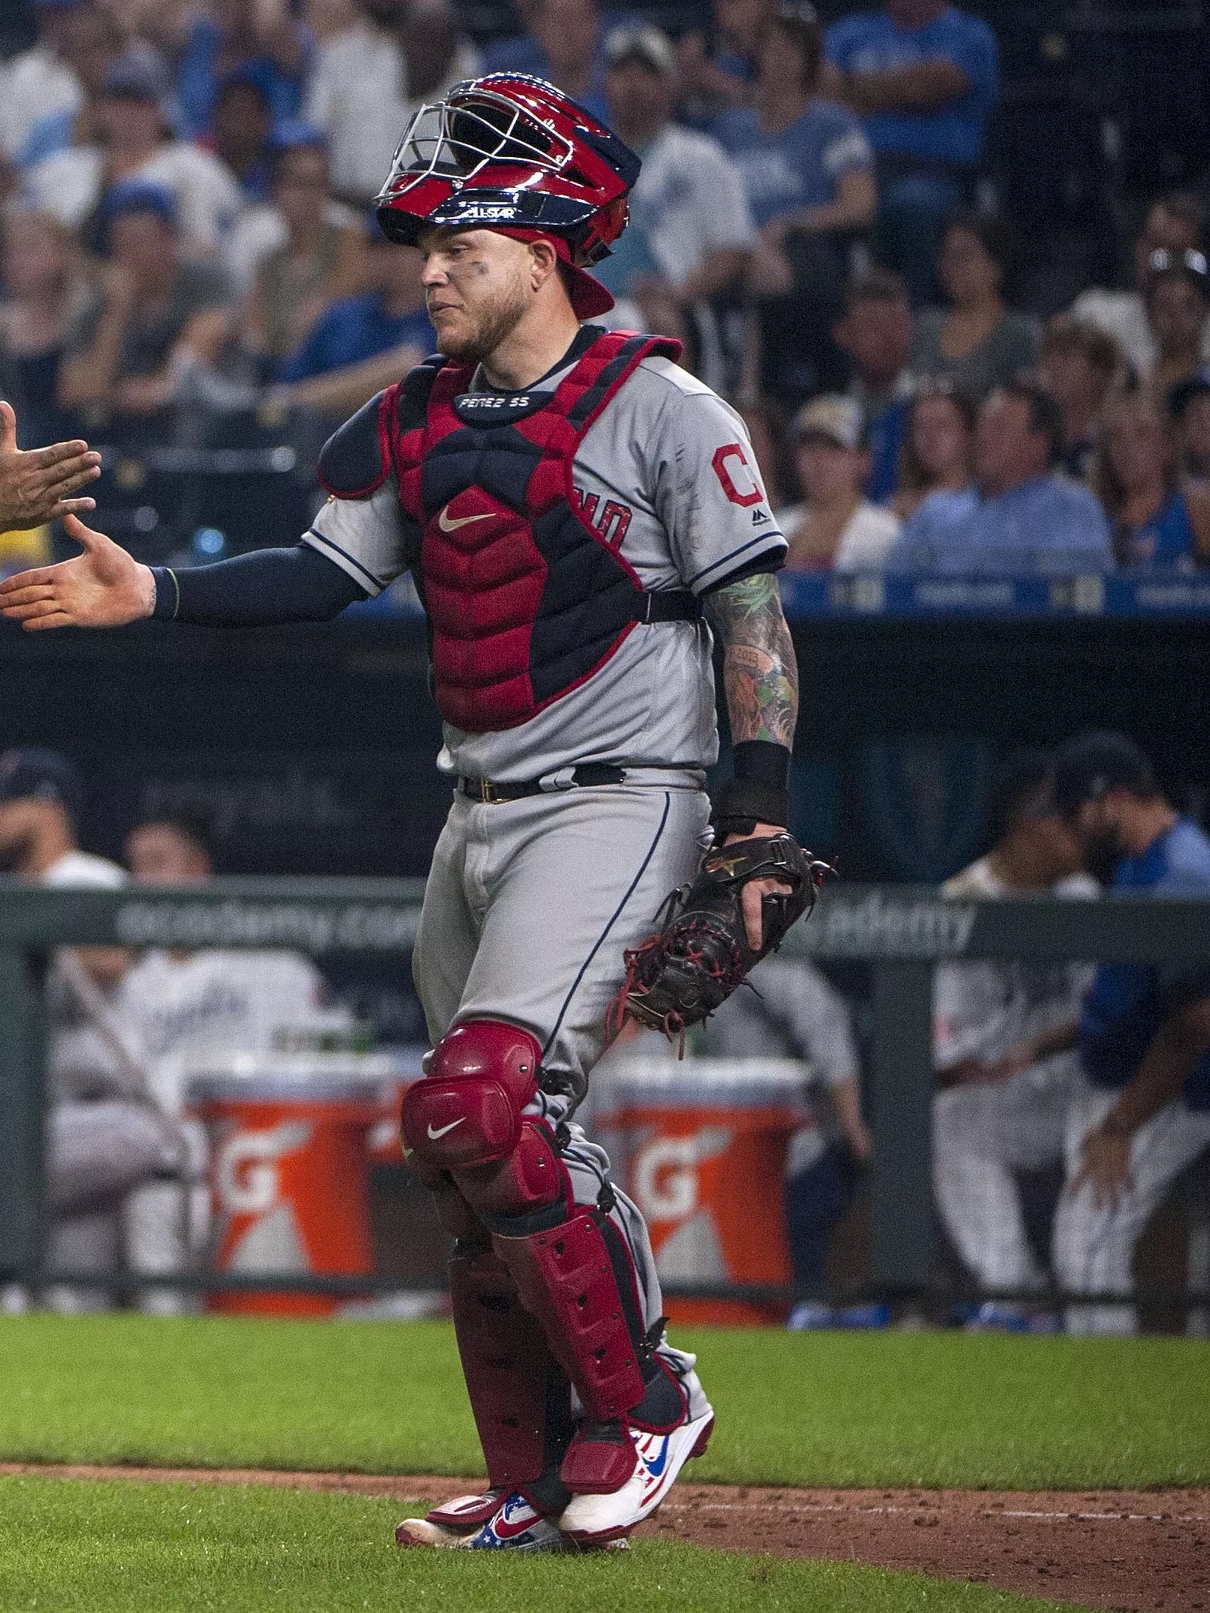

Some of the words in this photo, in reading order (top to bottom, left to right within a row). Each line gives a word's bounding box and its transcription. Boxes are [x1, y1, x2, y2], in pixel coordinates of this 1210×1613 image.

[710, 442, 764, 508] C
[217, 1124, 292, 1212] G
[632, 1131, 706, 1222] G
